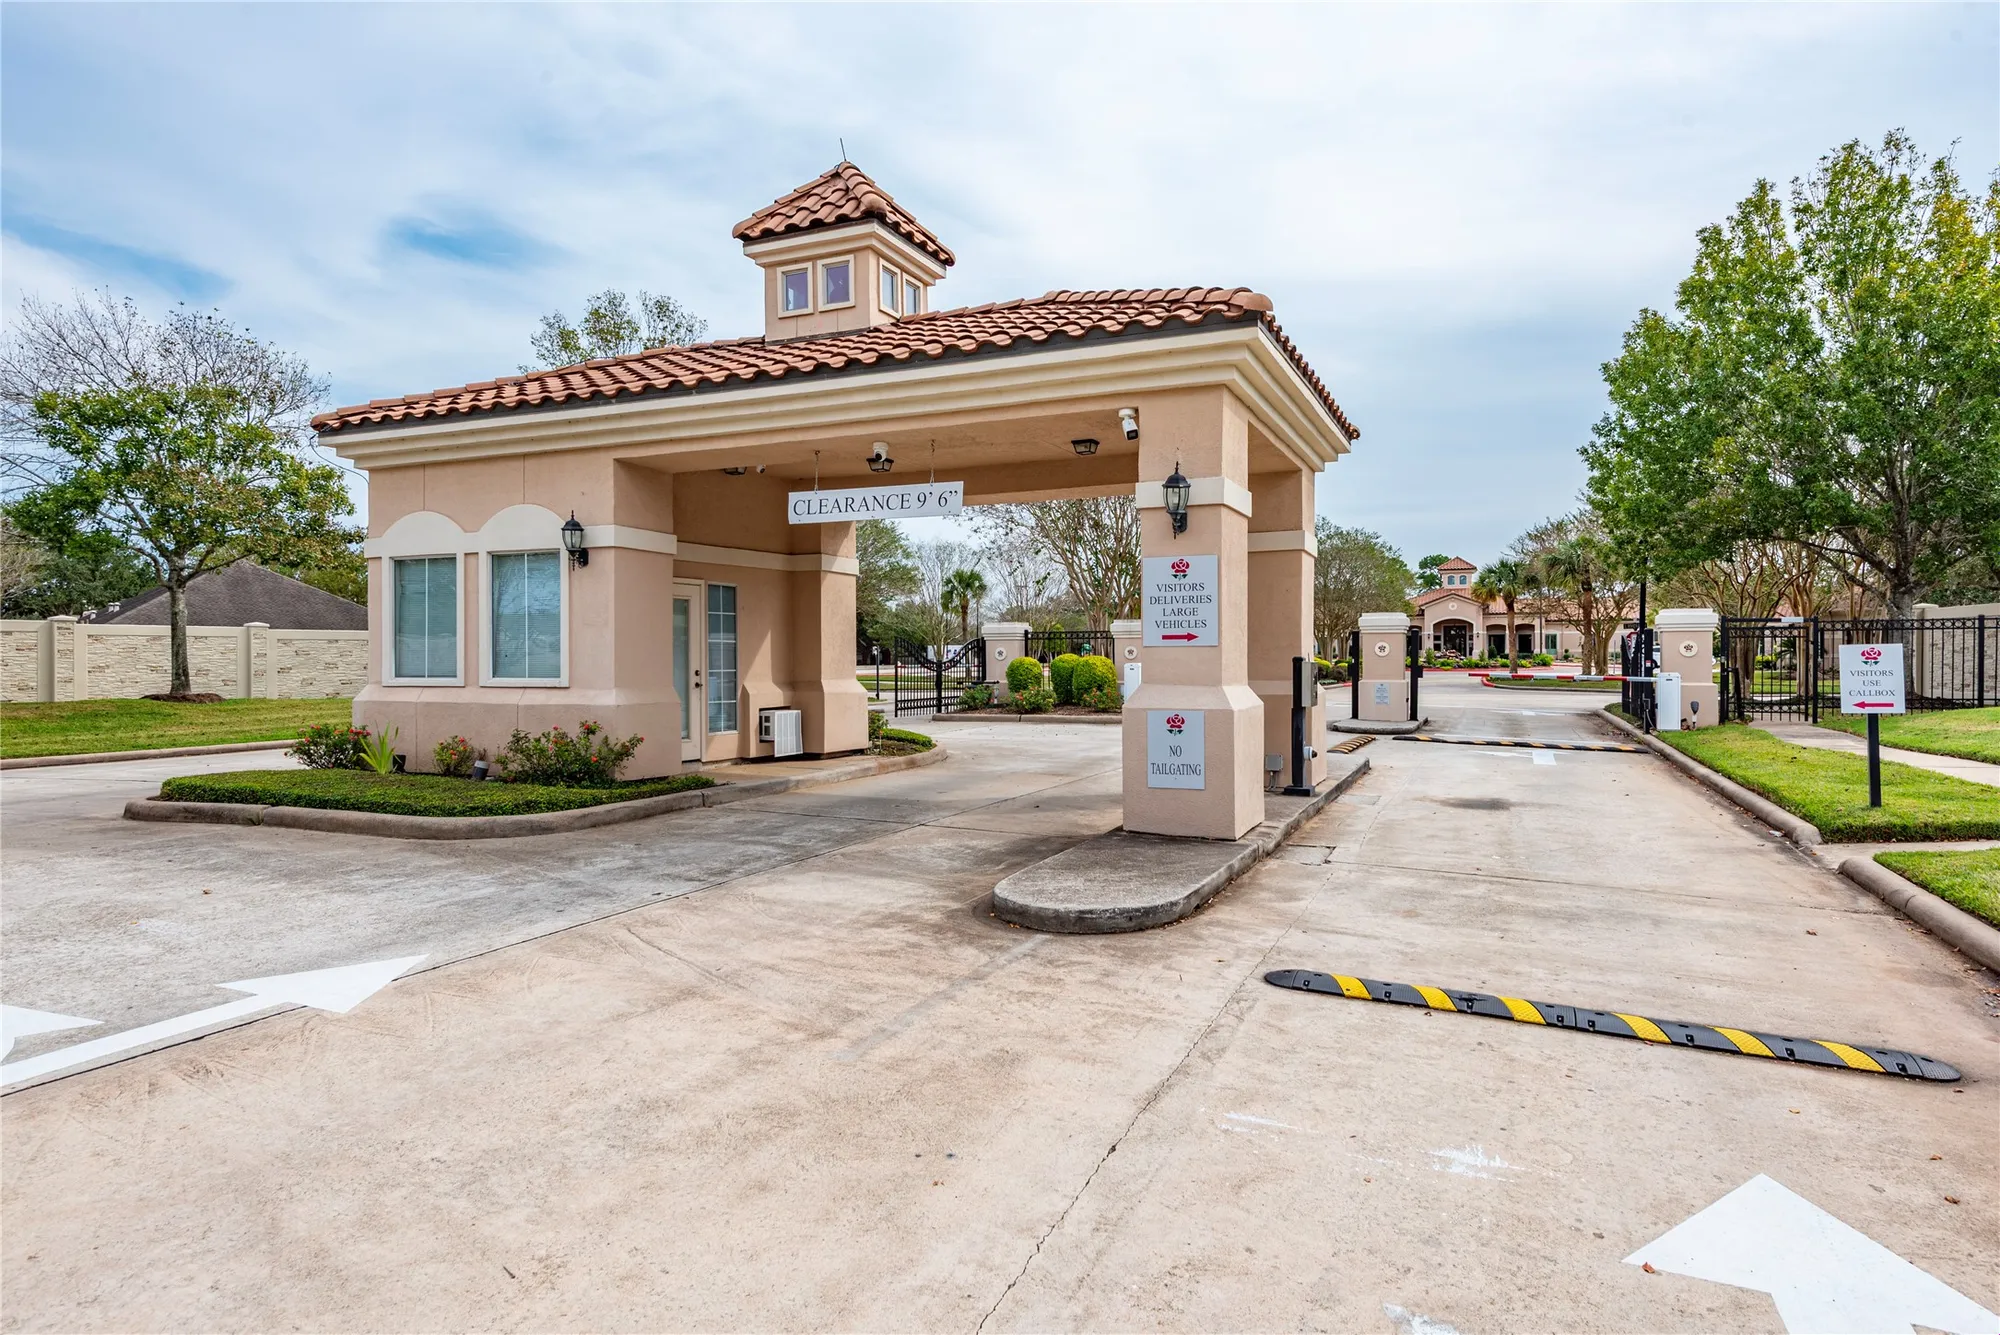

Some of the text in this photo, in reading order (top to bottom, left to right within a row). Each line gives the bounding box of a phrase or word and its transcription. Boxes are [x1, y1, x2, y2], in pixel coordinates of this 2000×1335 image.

[793, 493, 911, 516] CLEARANCE
[1156, 582, 1205, 592] VISITORS
[1149, 594, 1212, 605] DELIVERIES
[1162, 607, 1199, 617] LARGE
[1155, 619, 1207, 629] VEHICLES
[1850, 669, 1894, 677] VISITORS
[1862, 679, 1882, 687] USE
[1848, 689, 1896, 697] CALLBOX
[1169, 745, 1182, 757] NO
[1150, 763, 1201, 776] TAILGATING
